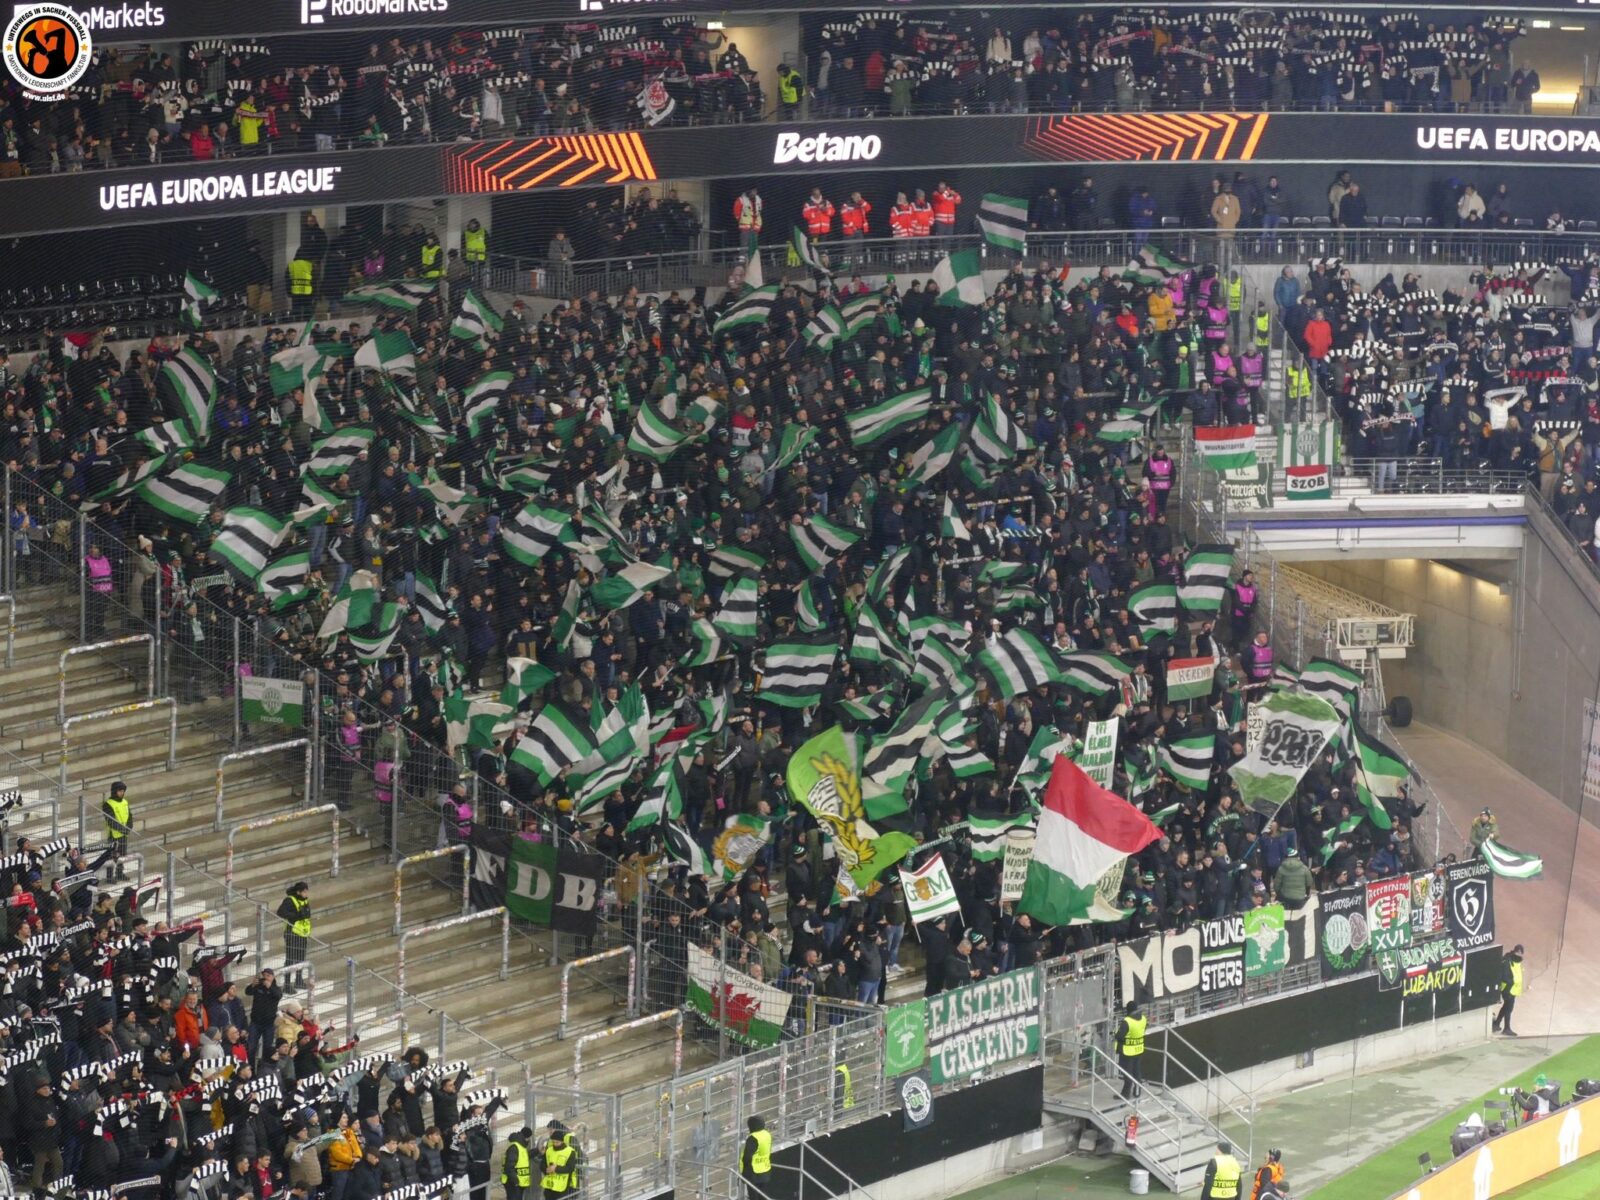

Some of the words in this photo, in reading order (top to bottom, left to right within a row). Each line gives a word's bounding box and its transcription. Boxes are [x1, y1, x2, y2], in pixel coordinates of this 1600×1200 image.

[773, 132, 881, 164] Betano
[1417, 127, 1488, 150] UEFA
[1495, 128, 1600, 152] EUROPA
[100, 182, 157, 211] UEFA
[162, 174, 247, 205] EUROPA
[1291, 476, 1325, 490] SZOB
[1202, 917, 1246, 948] YOUNG
[1202, 960, 1243, 991] STERS
[940, 1018, 1028, 1079] GREENS
